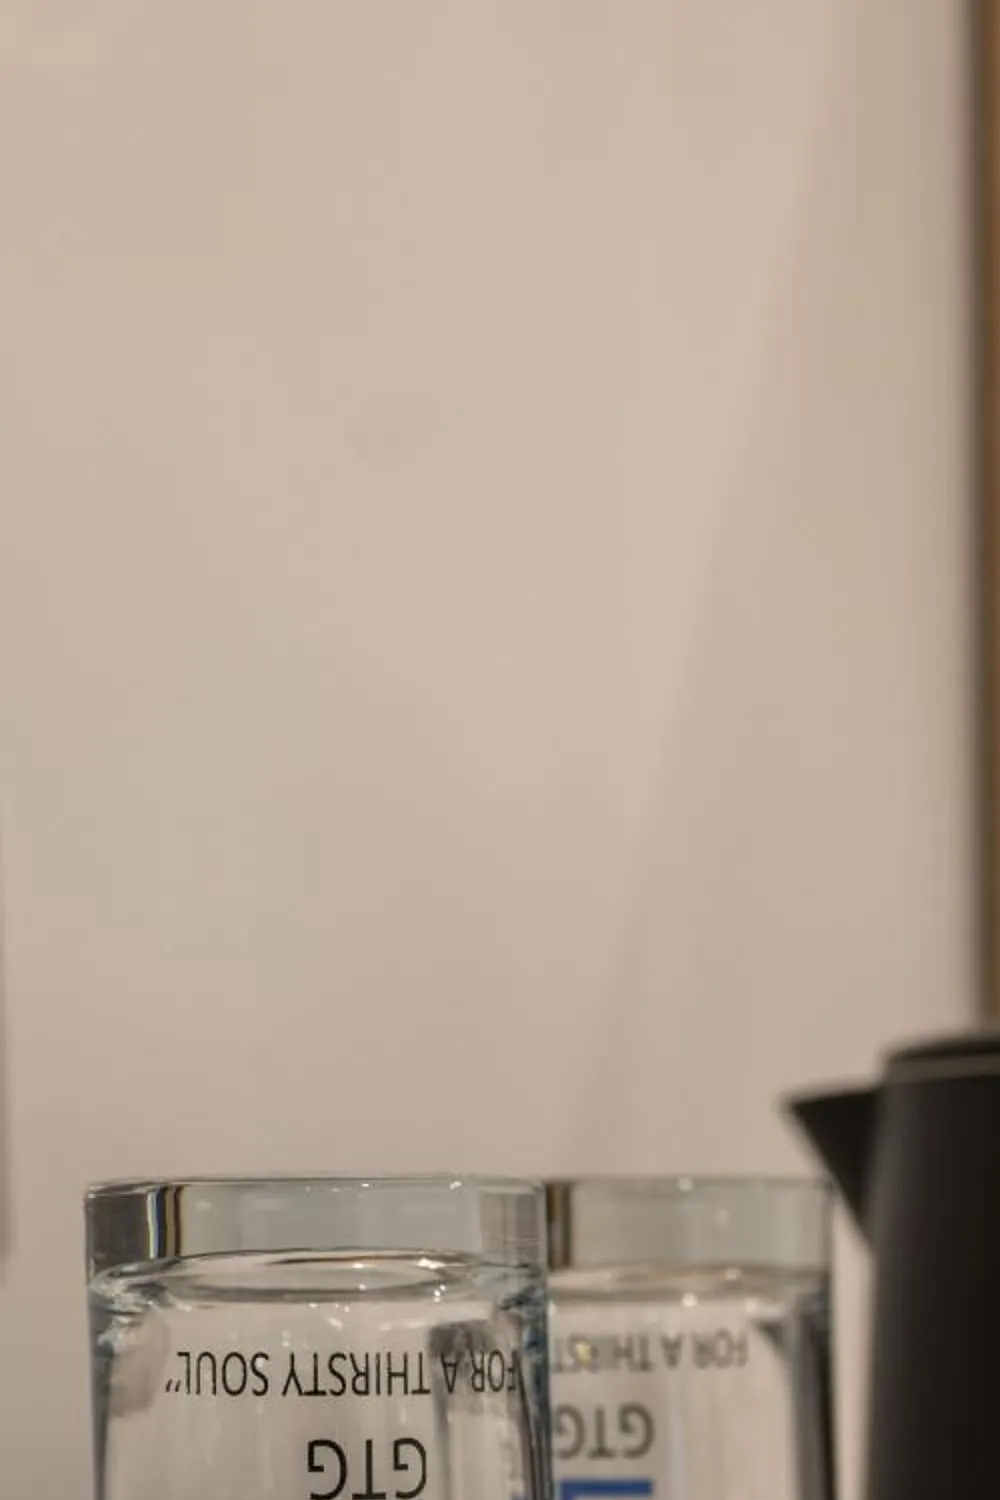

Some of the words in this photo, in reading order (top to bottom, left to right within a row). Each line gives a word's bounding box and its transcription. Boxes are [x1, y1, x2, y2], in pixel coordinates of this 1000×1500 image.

[472, 1349, 516, 1393] FOR
[659, 1331, 686, 1371] A
[690, 1327, 750, 1371] FOR
[281, 1351, 431, 1396] THIRSTY
[440, 1353, 458, 1394] A
[552, 1400, 656, 1461] GTG
